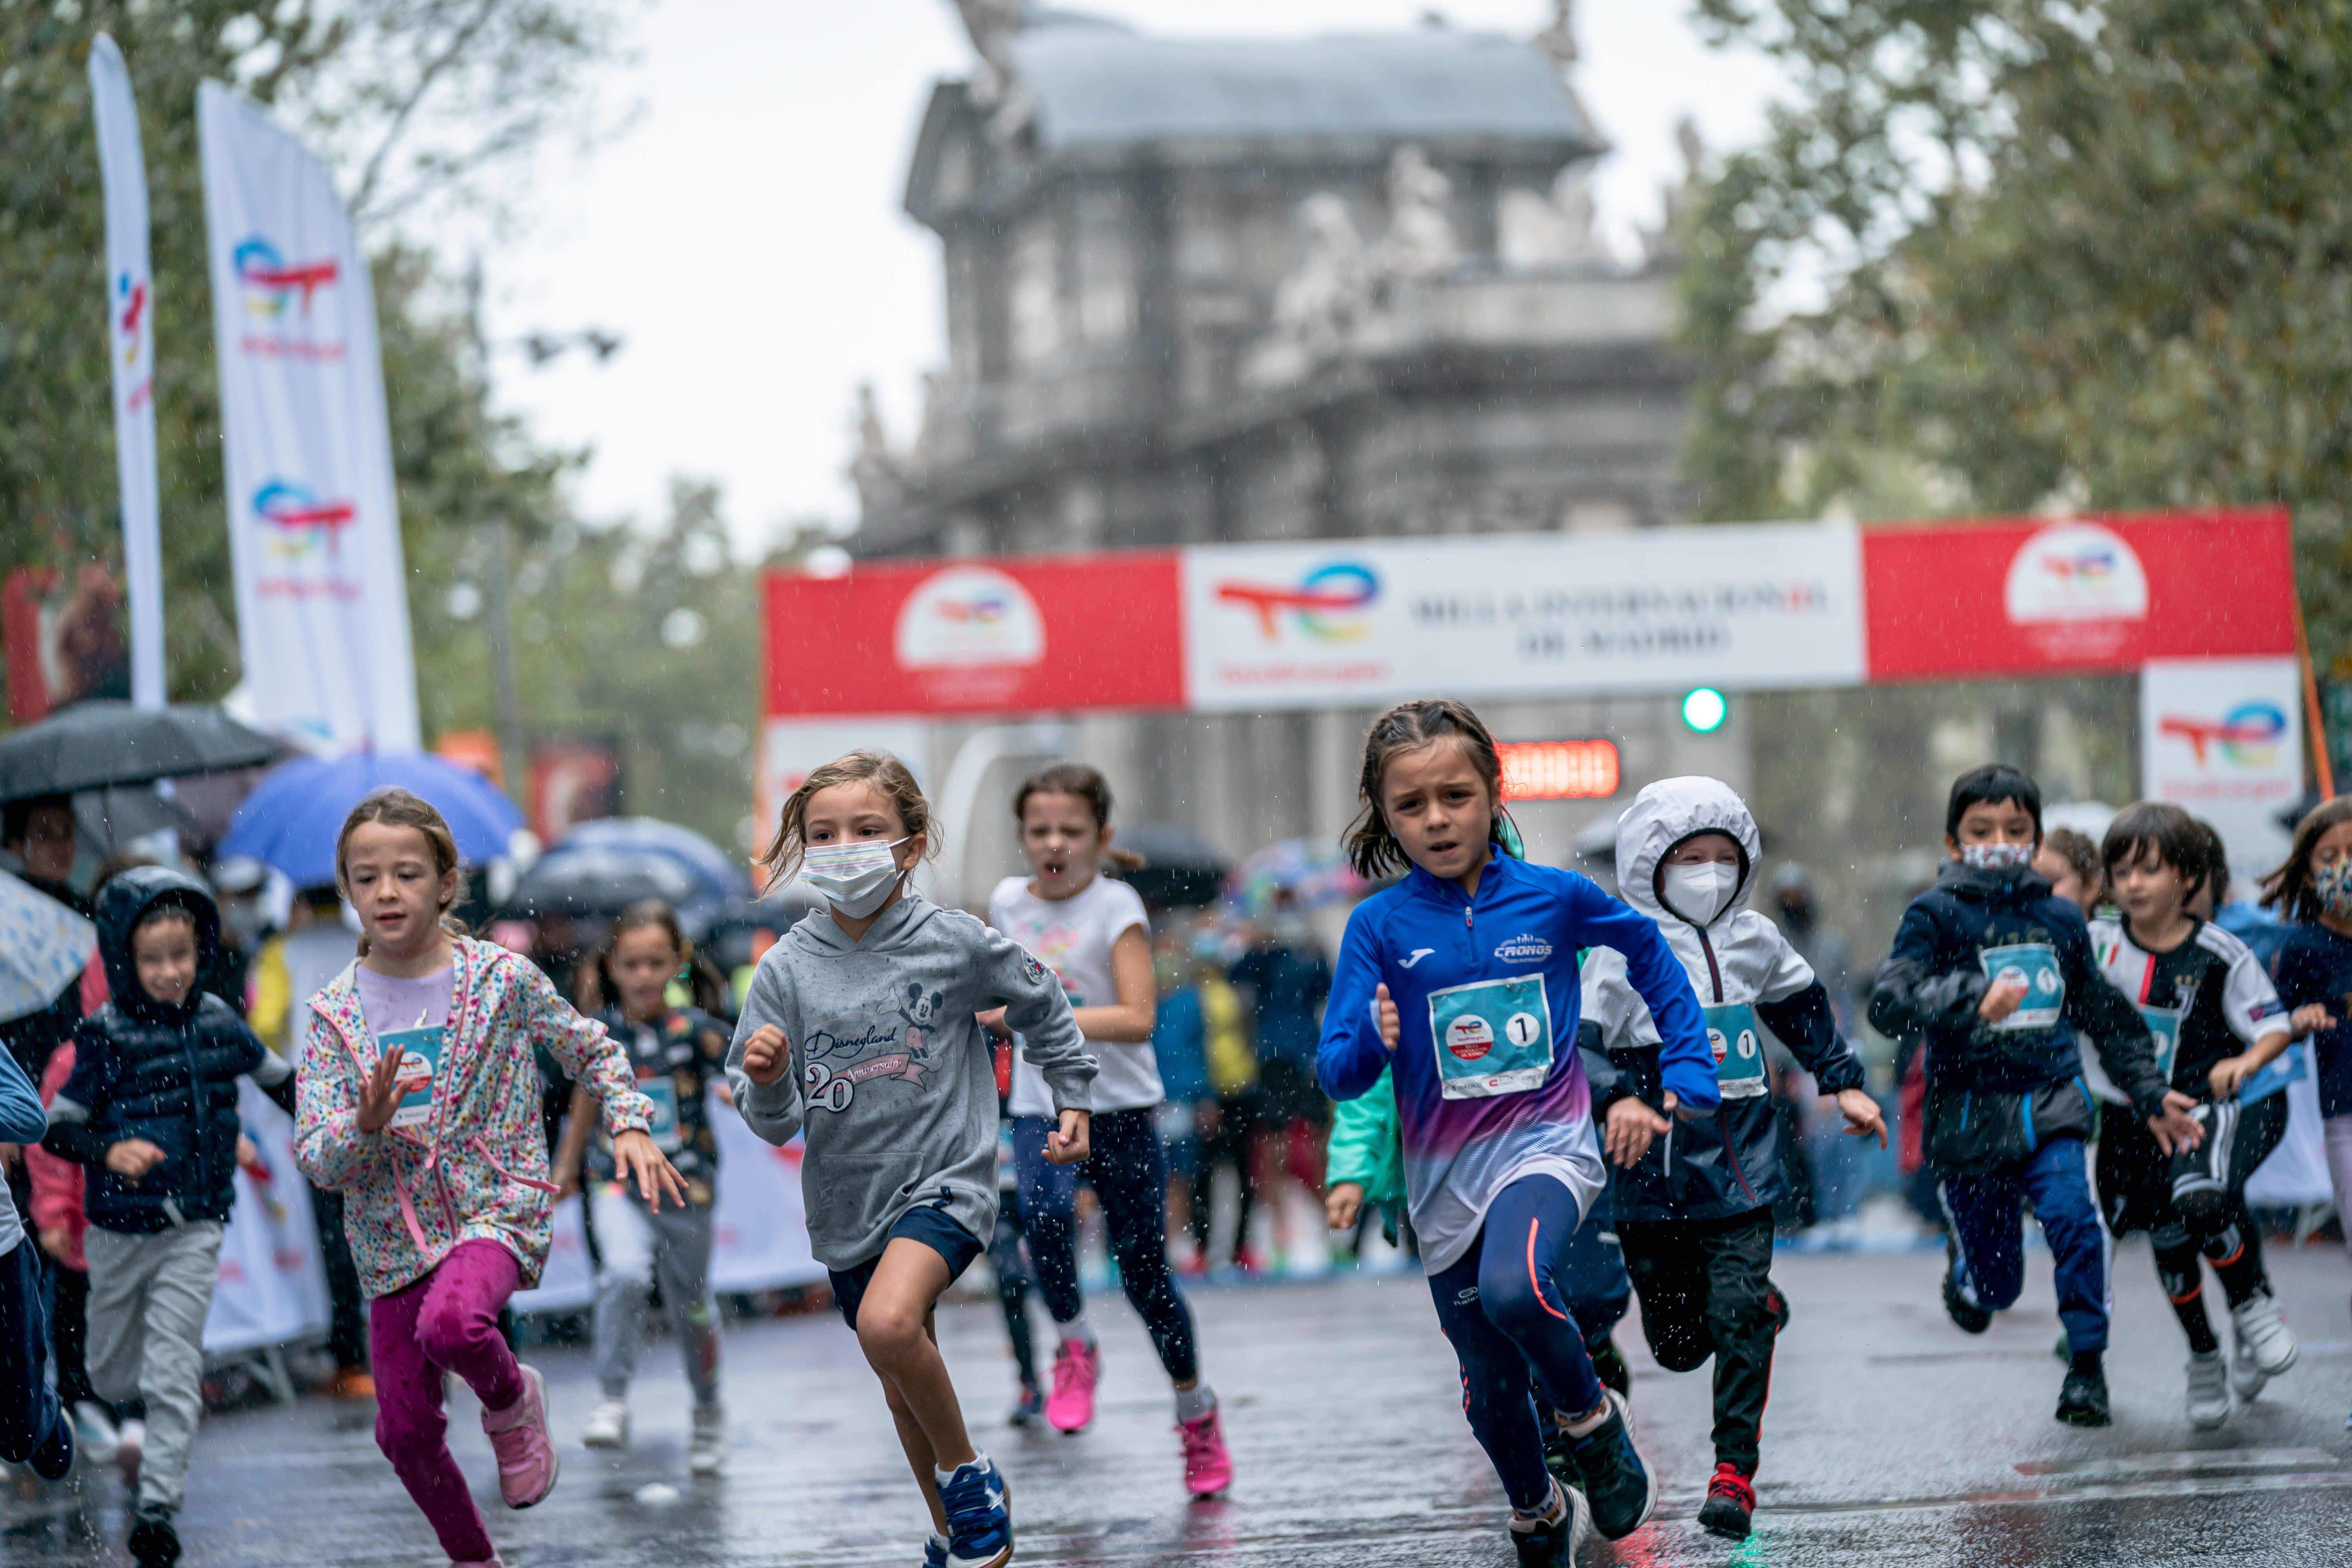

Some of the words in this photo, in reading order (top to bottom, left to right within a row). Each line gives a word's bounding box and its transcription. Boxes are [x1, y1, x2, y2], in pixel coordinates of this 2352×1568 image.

[1494, 945, 1553, 957] CRONOS
[1515, 1017, 1527, 1042] 1
[804, 1025, 897, 1060] Disneyland
[1744, 1034, 1750, 1055] 1
[805, 1063, 854, 1113] 20
[847, 1058, 901, 1082] Anniversaire
